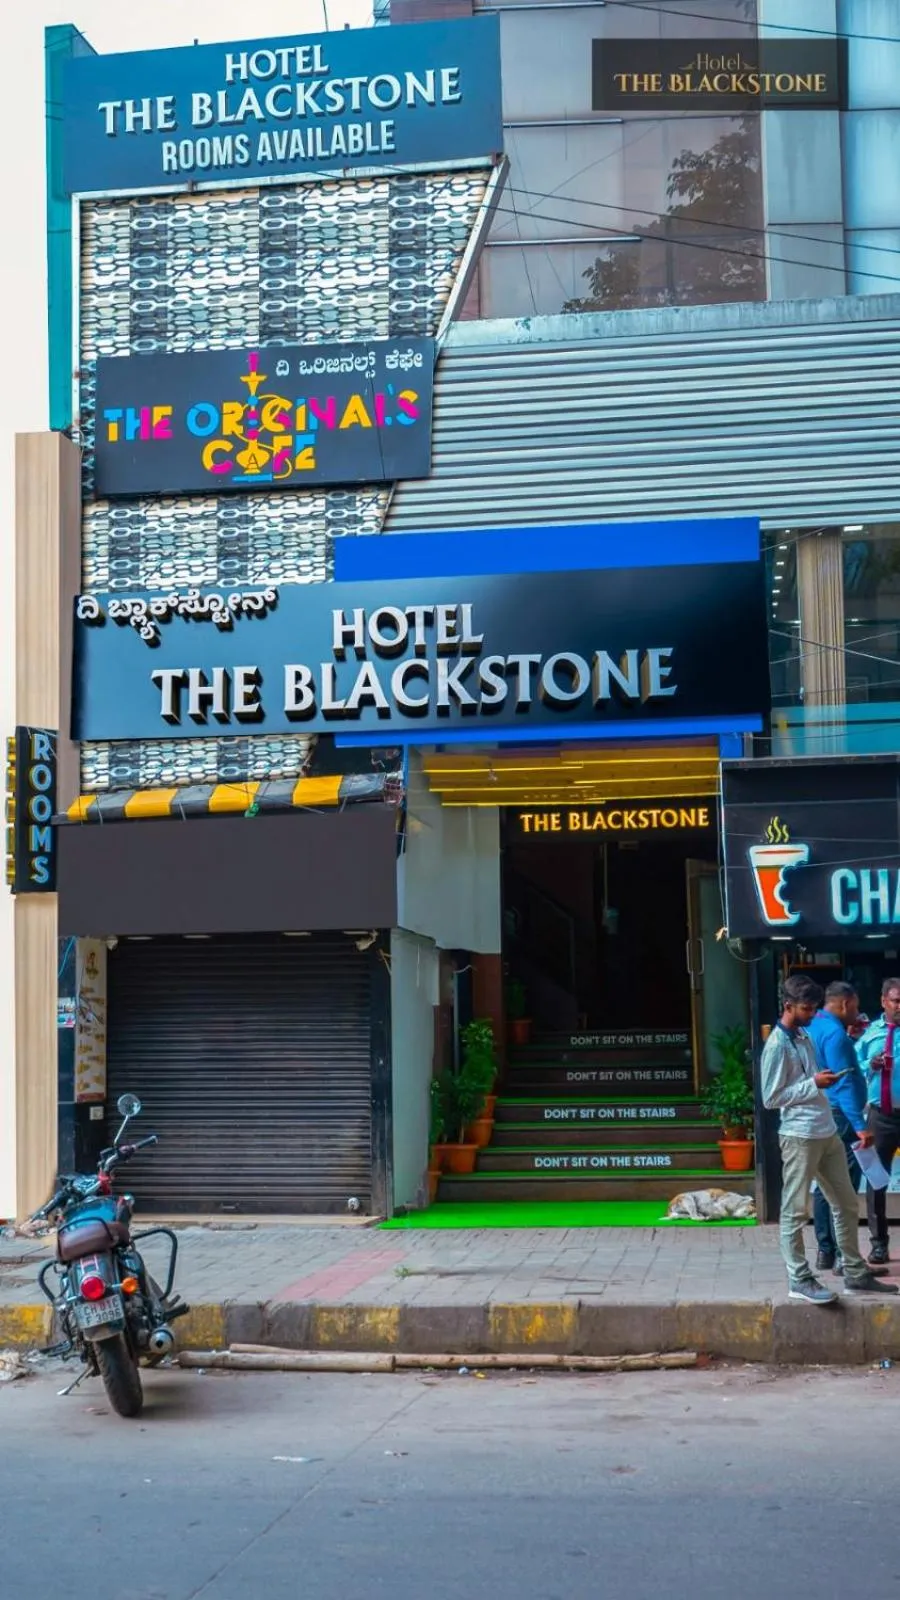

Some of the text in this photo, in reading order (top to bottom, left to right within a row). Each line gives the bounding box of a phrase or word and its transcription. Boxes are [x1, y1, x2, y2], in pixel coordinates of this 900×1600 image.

[225, 43, 329, 83] HOTEL
[98, 67, 462, 134] THE BLACKSTONE
[162, 120, 395, 172] ROOMS AVAILABLE
[275, 359, 290, 376] ದಿ
[103, 404, 173, 442] THE
[202, 433, 316, 474] CAFE
[77, 594, 99, 619] ದಿ
[332, 603, 484, 655] HOTEL
[151, 647, 677, 719] THE BLACKSTONE
[30, 733, 52, 884] ROOMS
[520, 808, 710, 832] THE BLACKSTONE
[570, 1033, 688, 1045] DON'T SIT ON THE STAIRS
[566, 1070, 688, 1081] DON'T SIT ON THE STAIRS
[544, 1108, 676, 1119] DON'T SIT ON THE STAIRS
[534, 1155, 672, 1168] DON'T SIT ON THE STAIRS
